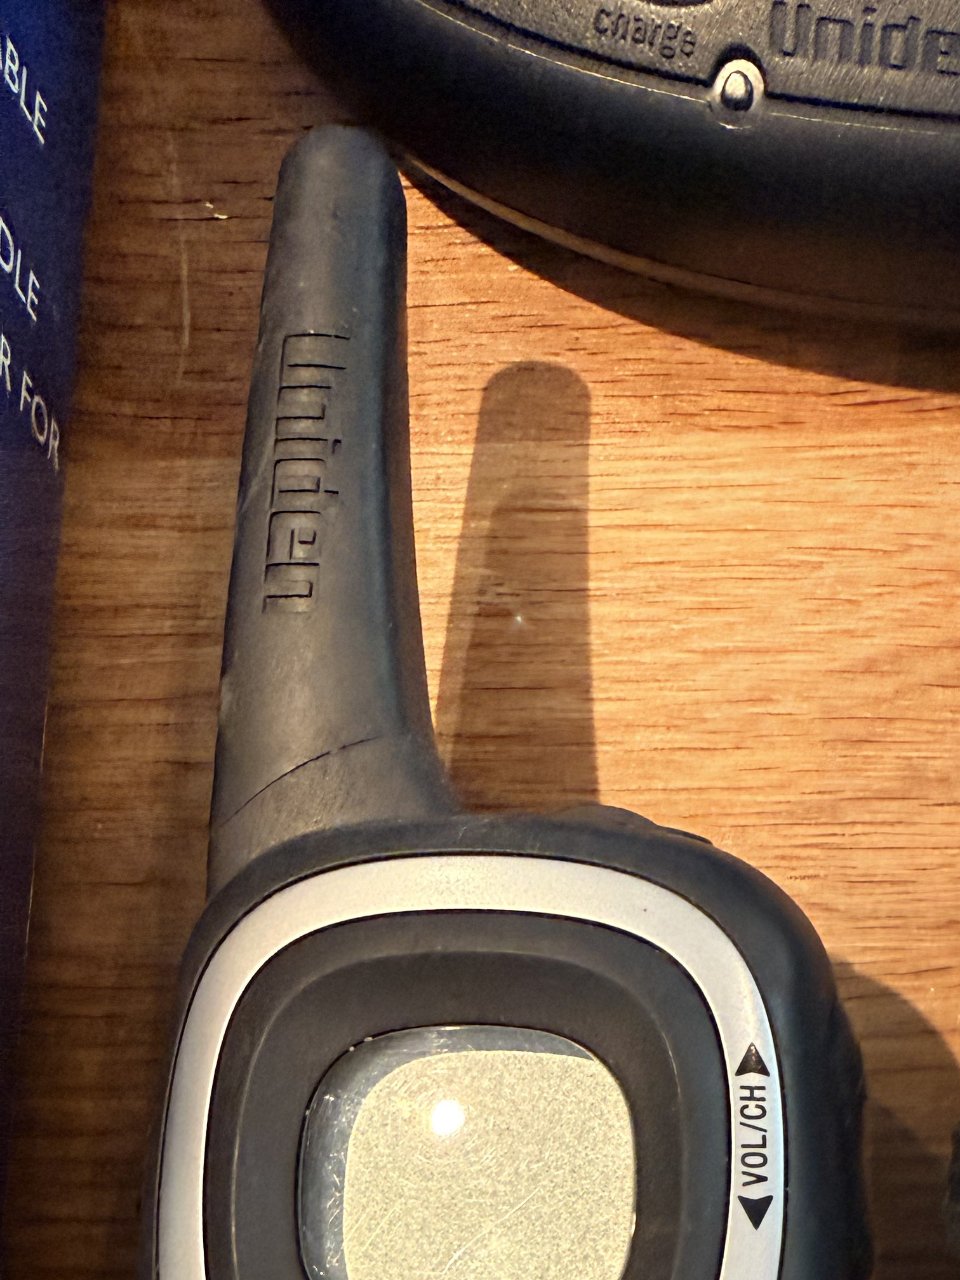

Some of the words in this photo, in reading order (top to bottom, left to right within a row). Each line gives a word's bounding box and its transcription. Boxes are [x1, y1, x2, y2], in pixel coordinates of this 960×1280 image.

[594, 8, 697, 59] charge
[0, 34, 48, 145] BLE
[20, 370, 60, 472] FOR
[739, 1085, 769, 1187] VOL/CH
